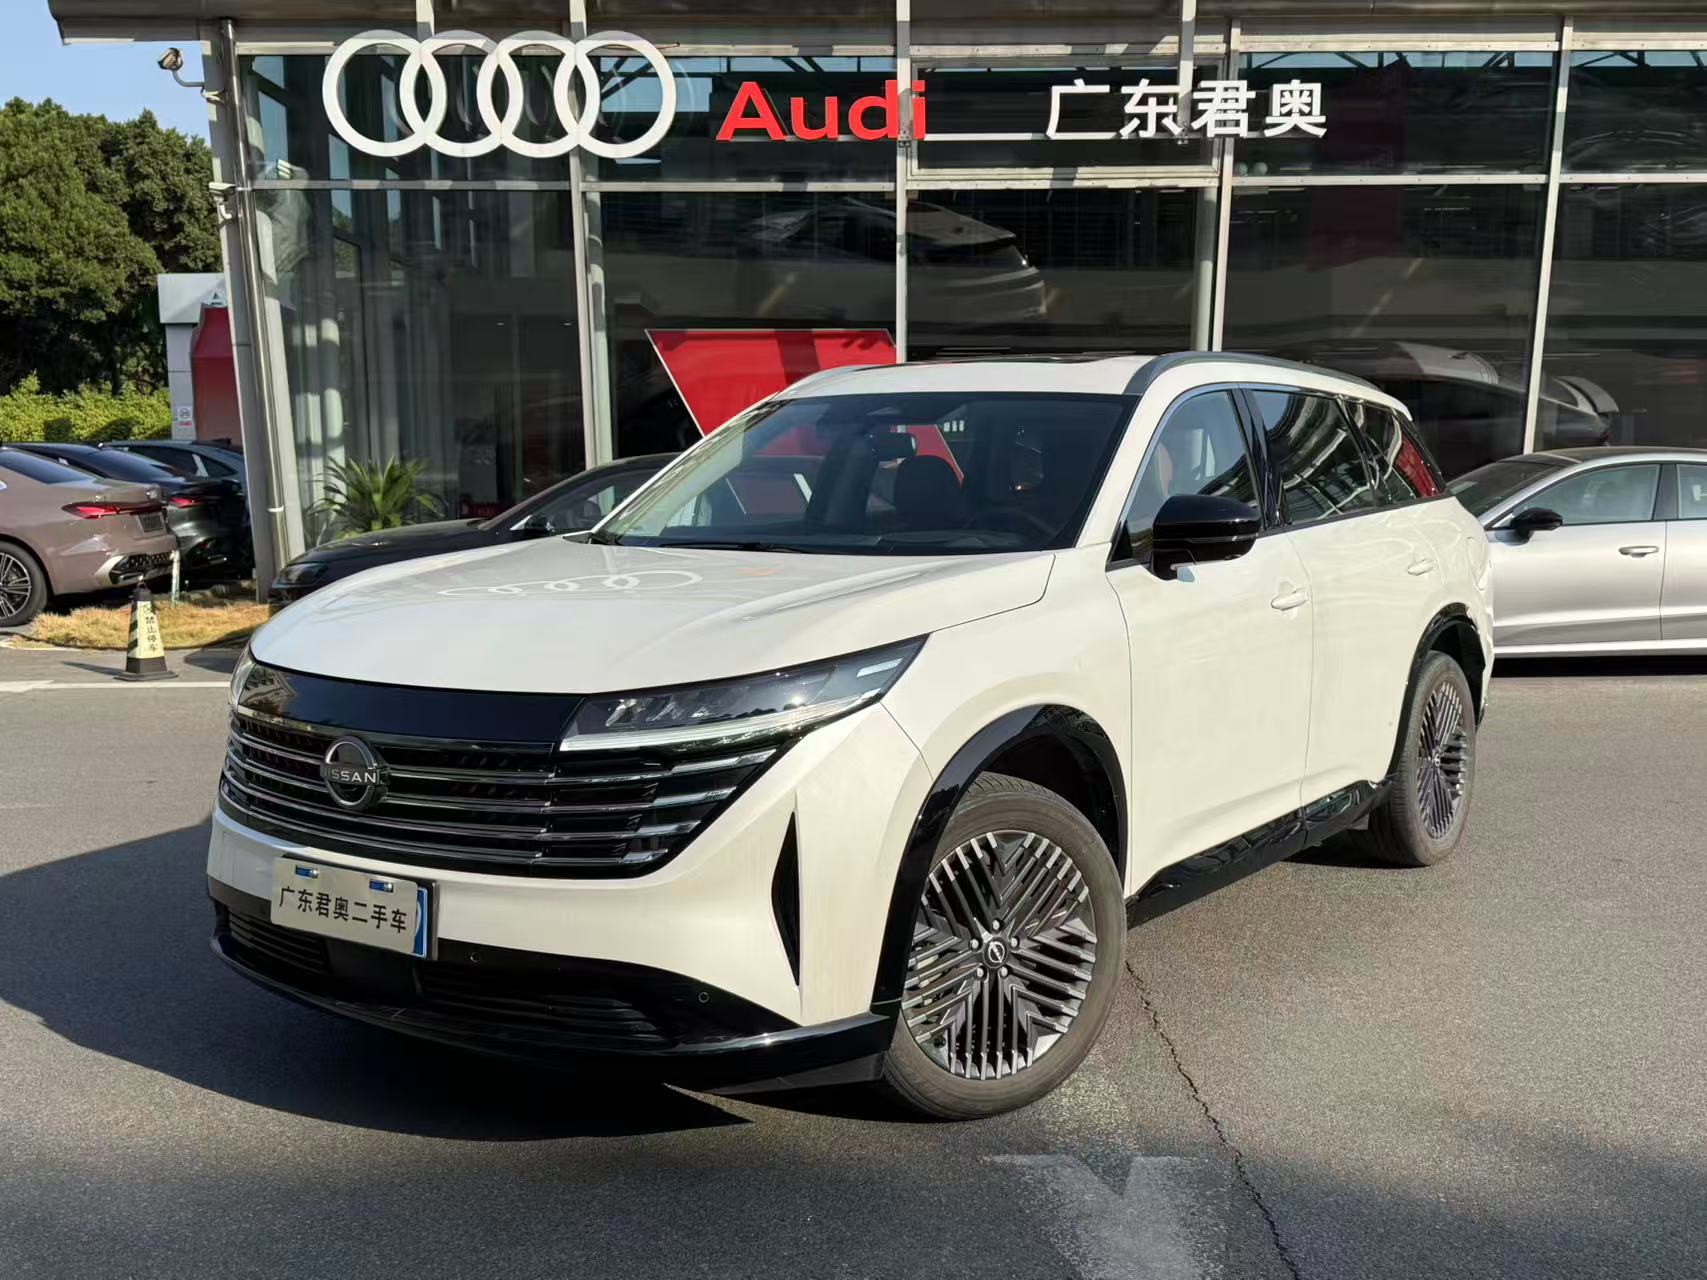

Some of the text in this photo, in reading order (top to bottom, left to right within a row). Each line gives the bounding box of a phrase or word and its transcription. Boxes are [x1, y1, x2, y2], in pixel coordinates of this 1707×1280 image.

[715, 79, 926, 141] Audi
[1046, 79, 1327, 138] 广东君奥
[279, 885, 407, 934] 广东君奥二手车
